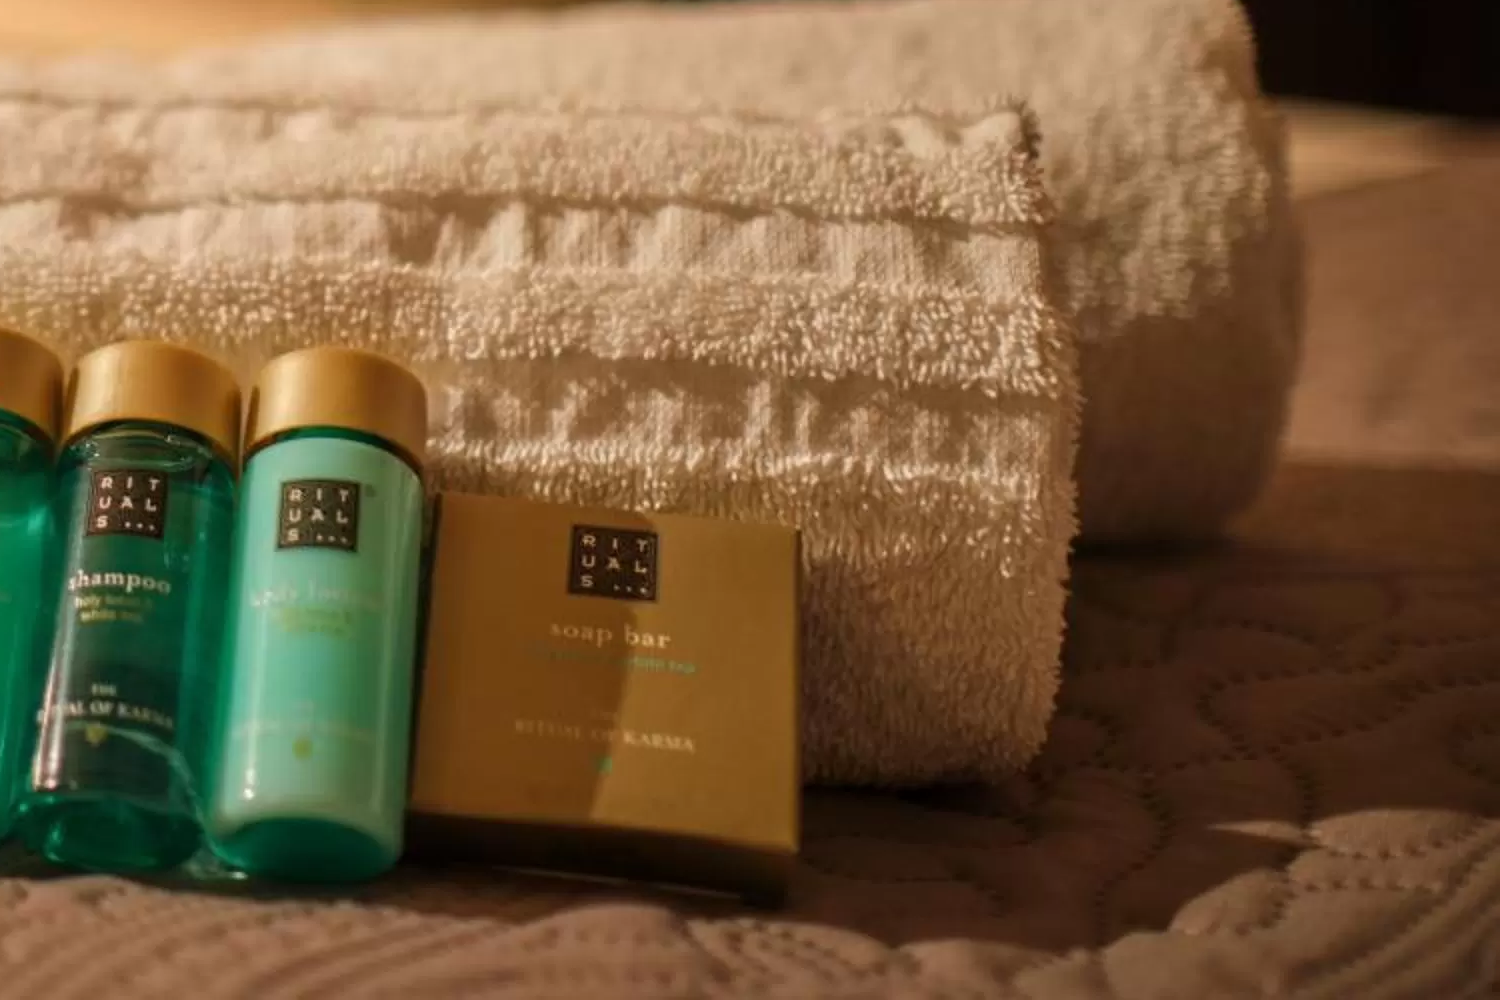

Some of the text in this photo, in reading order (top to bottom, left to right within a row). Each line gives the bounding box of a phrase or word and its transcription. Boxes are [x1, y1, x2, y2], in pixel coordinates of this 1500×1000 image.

[67, 568, 172, 595] shampoo
[551, 622, 673, 649] soap bar
